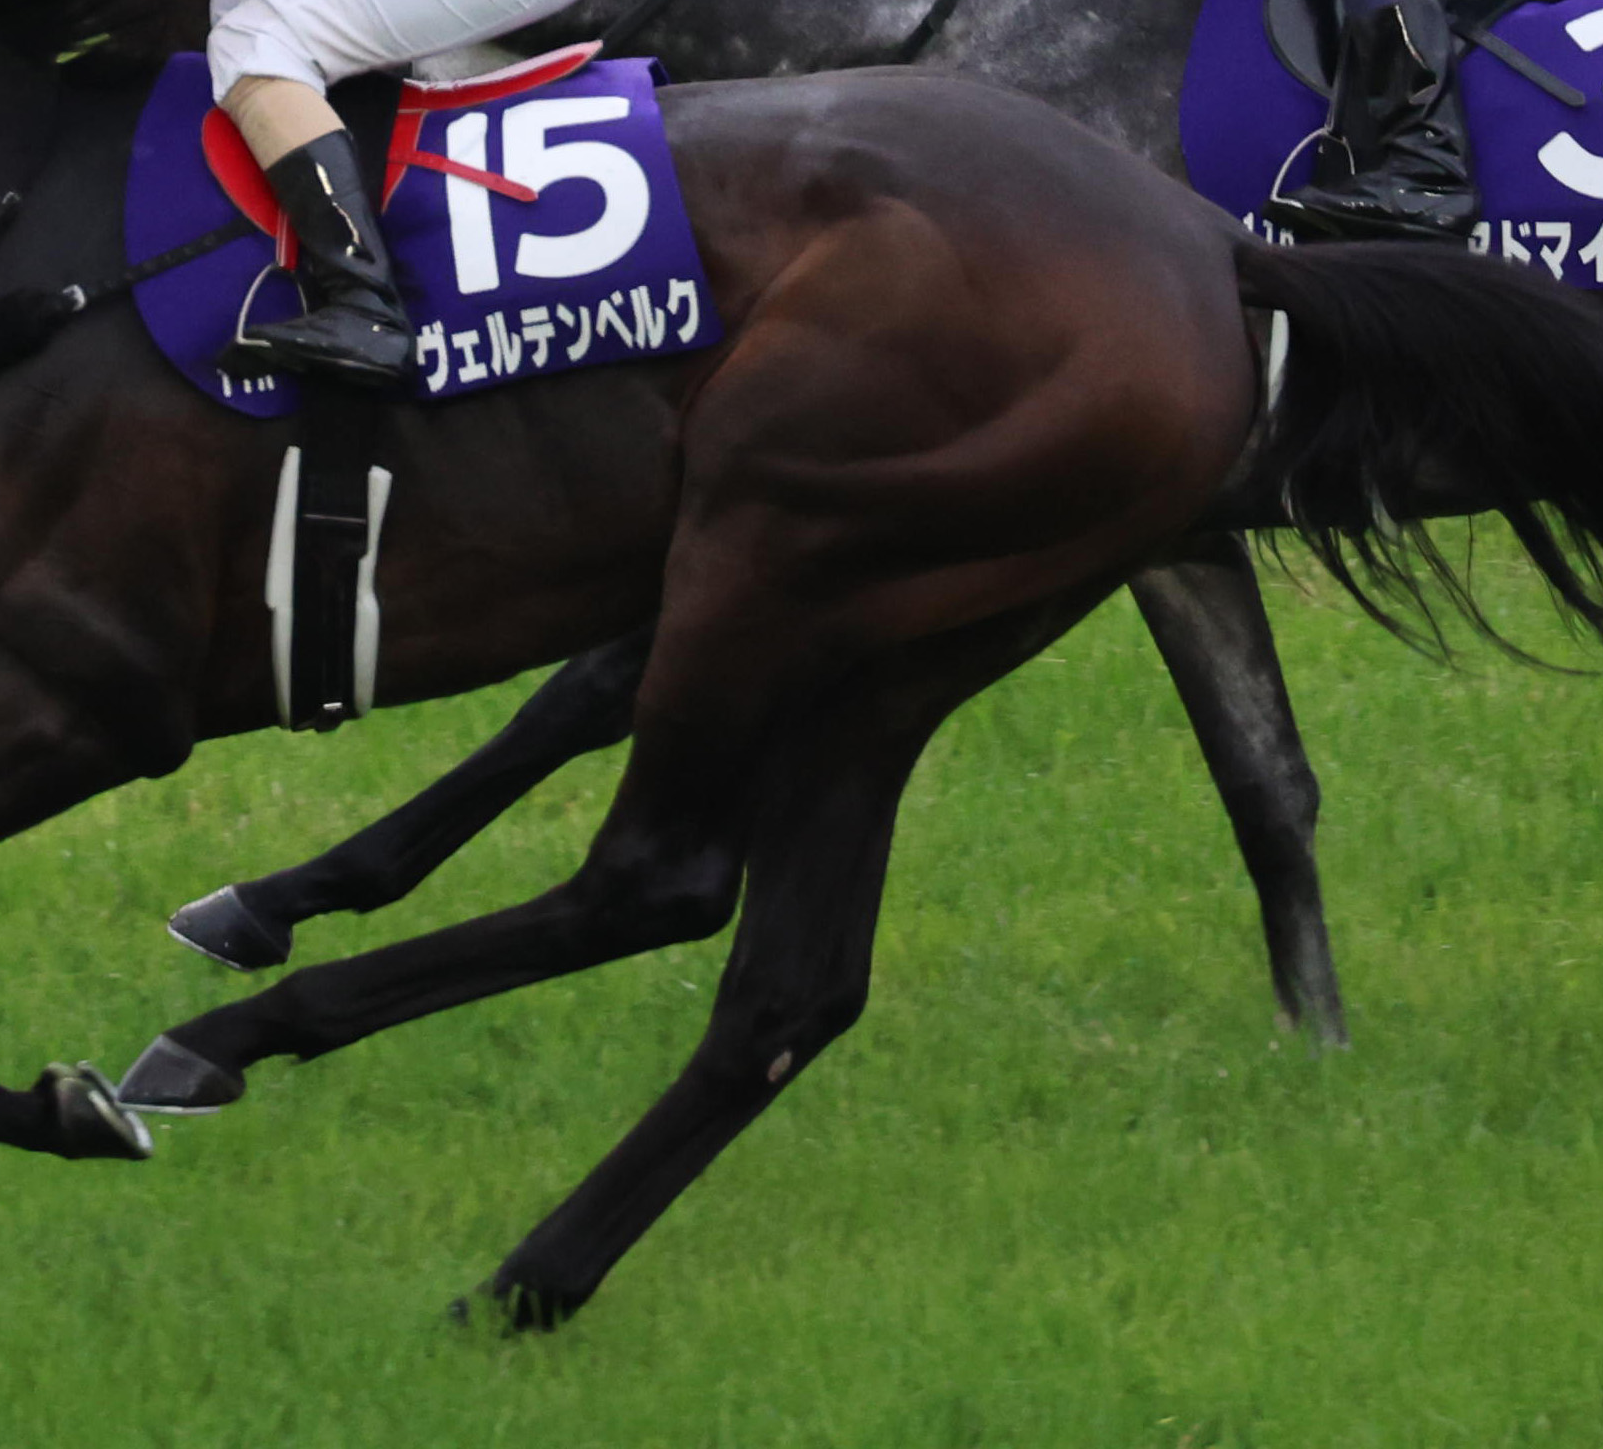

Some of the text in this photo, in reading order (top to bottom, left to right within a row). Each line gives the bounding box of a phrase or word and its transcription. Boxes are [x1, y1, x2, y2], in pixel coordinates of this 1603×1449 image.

[446, 95, 650, 294] 15
[417, 278, 700, 393] ヴェルテンベルク
